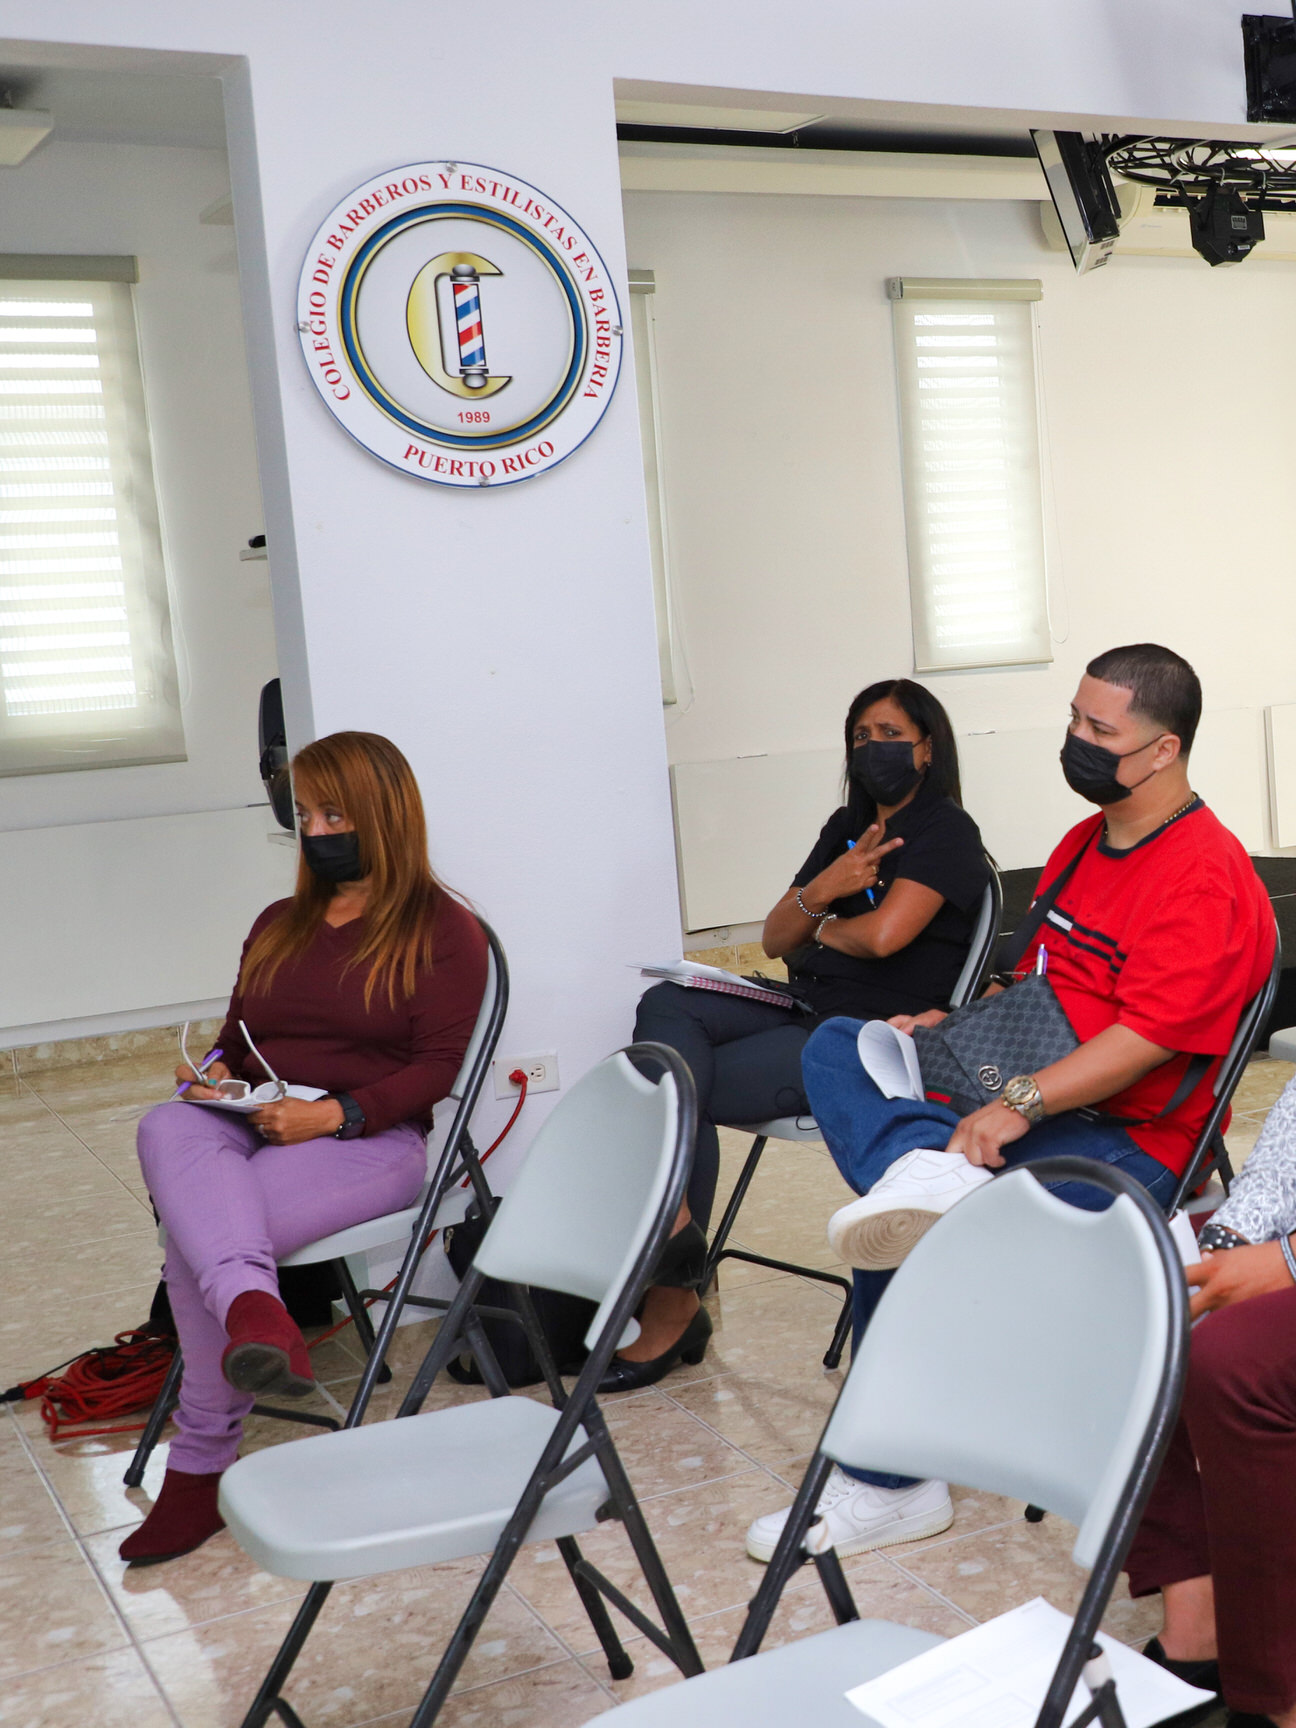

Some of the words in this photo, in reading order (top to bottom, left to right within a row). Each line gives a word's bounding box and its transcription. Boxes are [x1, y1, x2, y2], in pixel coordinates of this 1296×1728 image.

[438, 173, 451, 189] Y
[327, 176, 431, 250] BARBEROS
[461, 175, 576, 250] ESTILISTAS
[312, 253, 336, 286] DE
[573, 252, 598, 282] EN
[309, 291, 351, 401] COLEGIO
[584, 288, 611, 397] BARBERIA
[458, 411, 490, 423] 1989
[404, 445, 496, 477] PUERTO
[502, 441, 554, 474] RICO
